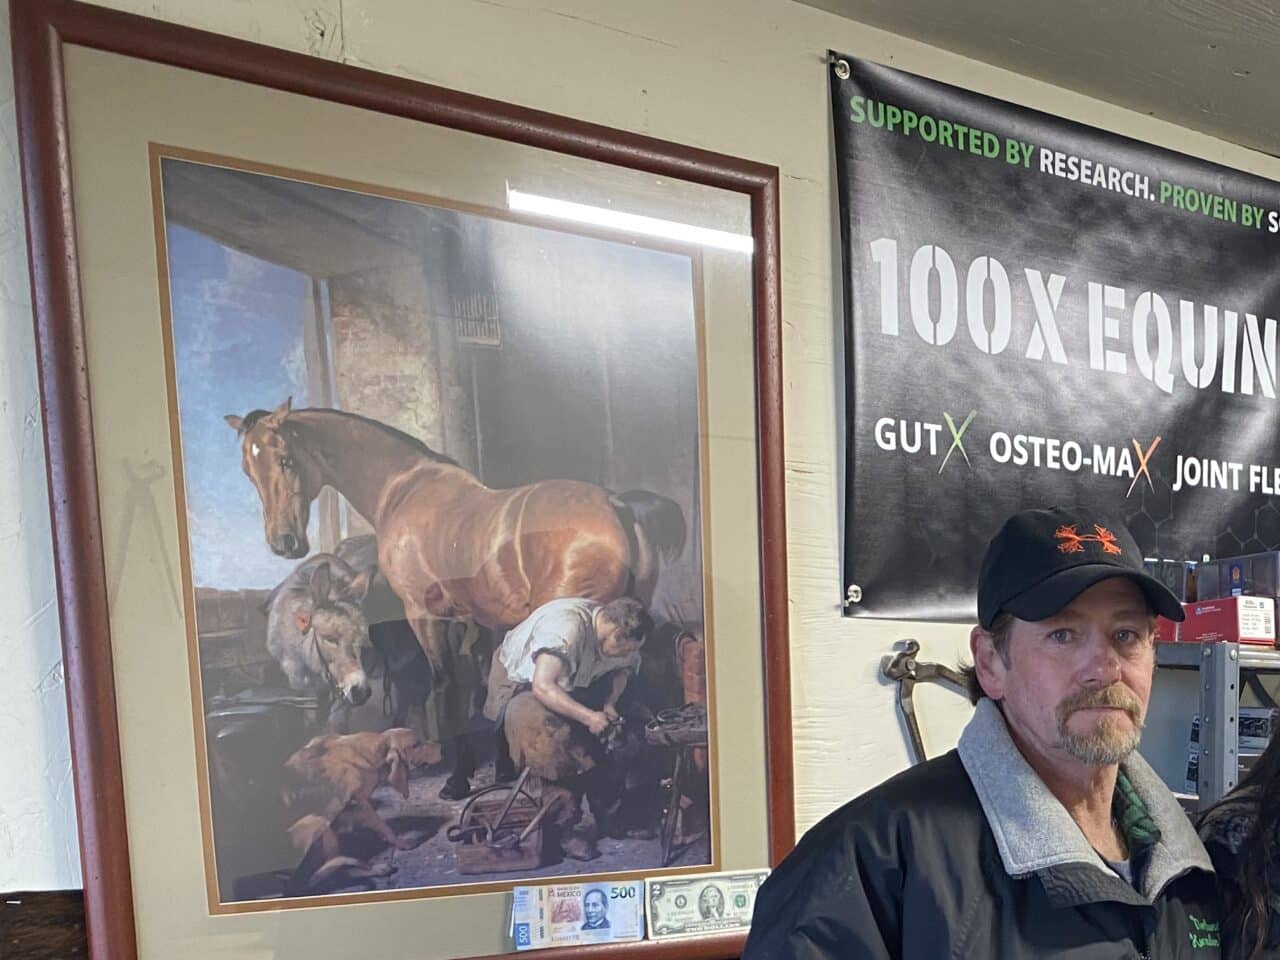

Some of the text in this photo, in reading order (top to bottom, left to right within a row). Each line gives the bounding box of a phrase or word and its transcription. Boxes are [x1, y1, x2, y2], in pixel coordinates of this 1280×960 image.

[850, 95, 1000, 159] SUPPORTED
[1005, 138, 1035, 168] BY
[1040, 148, 1155, 200] RESEARCH.
[1160, 181, 1237, 223] PROVEN
[1241, 203, 1264, 229] BY
[869, 238, 1067, 365] 100X
[1172, 454, 1243, 492] JOINT
[610, 886, 636, 899] 500
[653, 883, 661, 895] 2
[519, 925, 528, 944] 500
